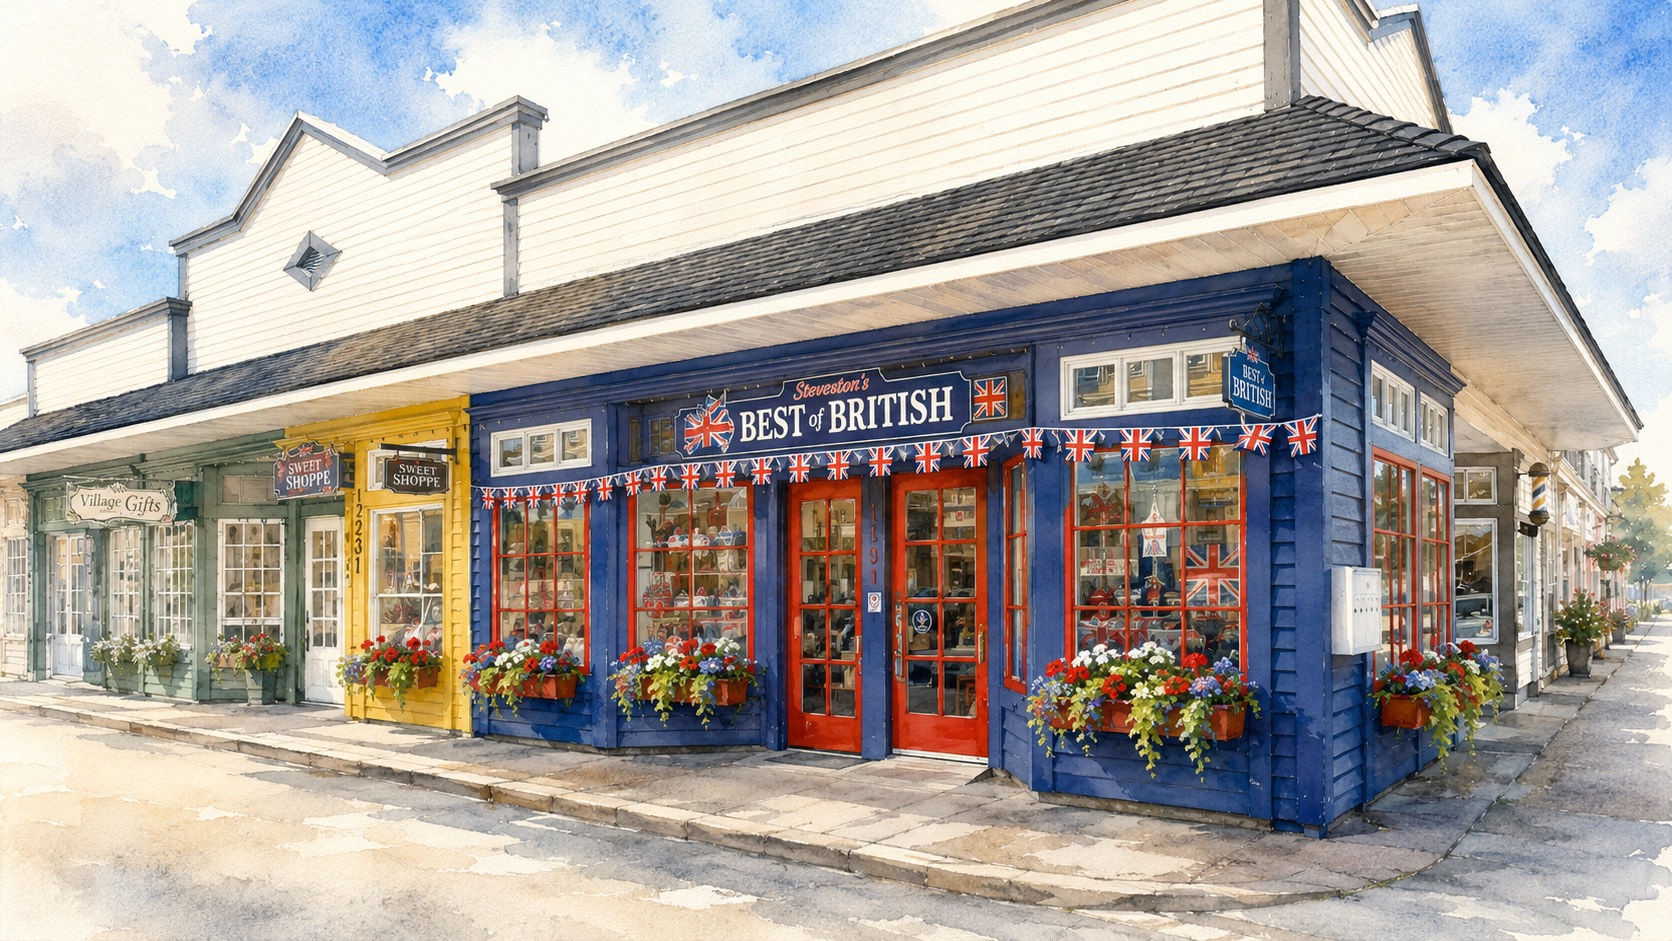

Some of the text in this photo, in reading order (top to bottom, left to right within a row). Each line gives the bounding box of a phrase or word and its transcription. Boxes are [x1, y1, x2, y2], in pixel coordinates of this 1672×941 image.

[1243, 364, 1260, 383] BEST
[793, 374, 869, 400] Steveston's
[1233, 376, 1272, 408] BRITISH
[740, 386, 953, 442] BEST of BRITISH
[286, 470, 331, 490] SHOPPE
[393, 473, 440, 488] SHOPPE
[399, 463, 437, 476] SWEET
[80, 493, 161, 517] Village Gifts
[354, 488, 363, 574] 12231
